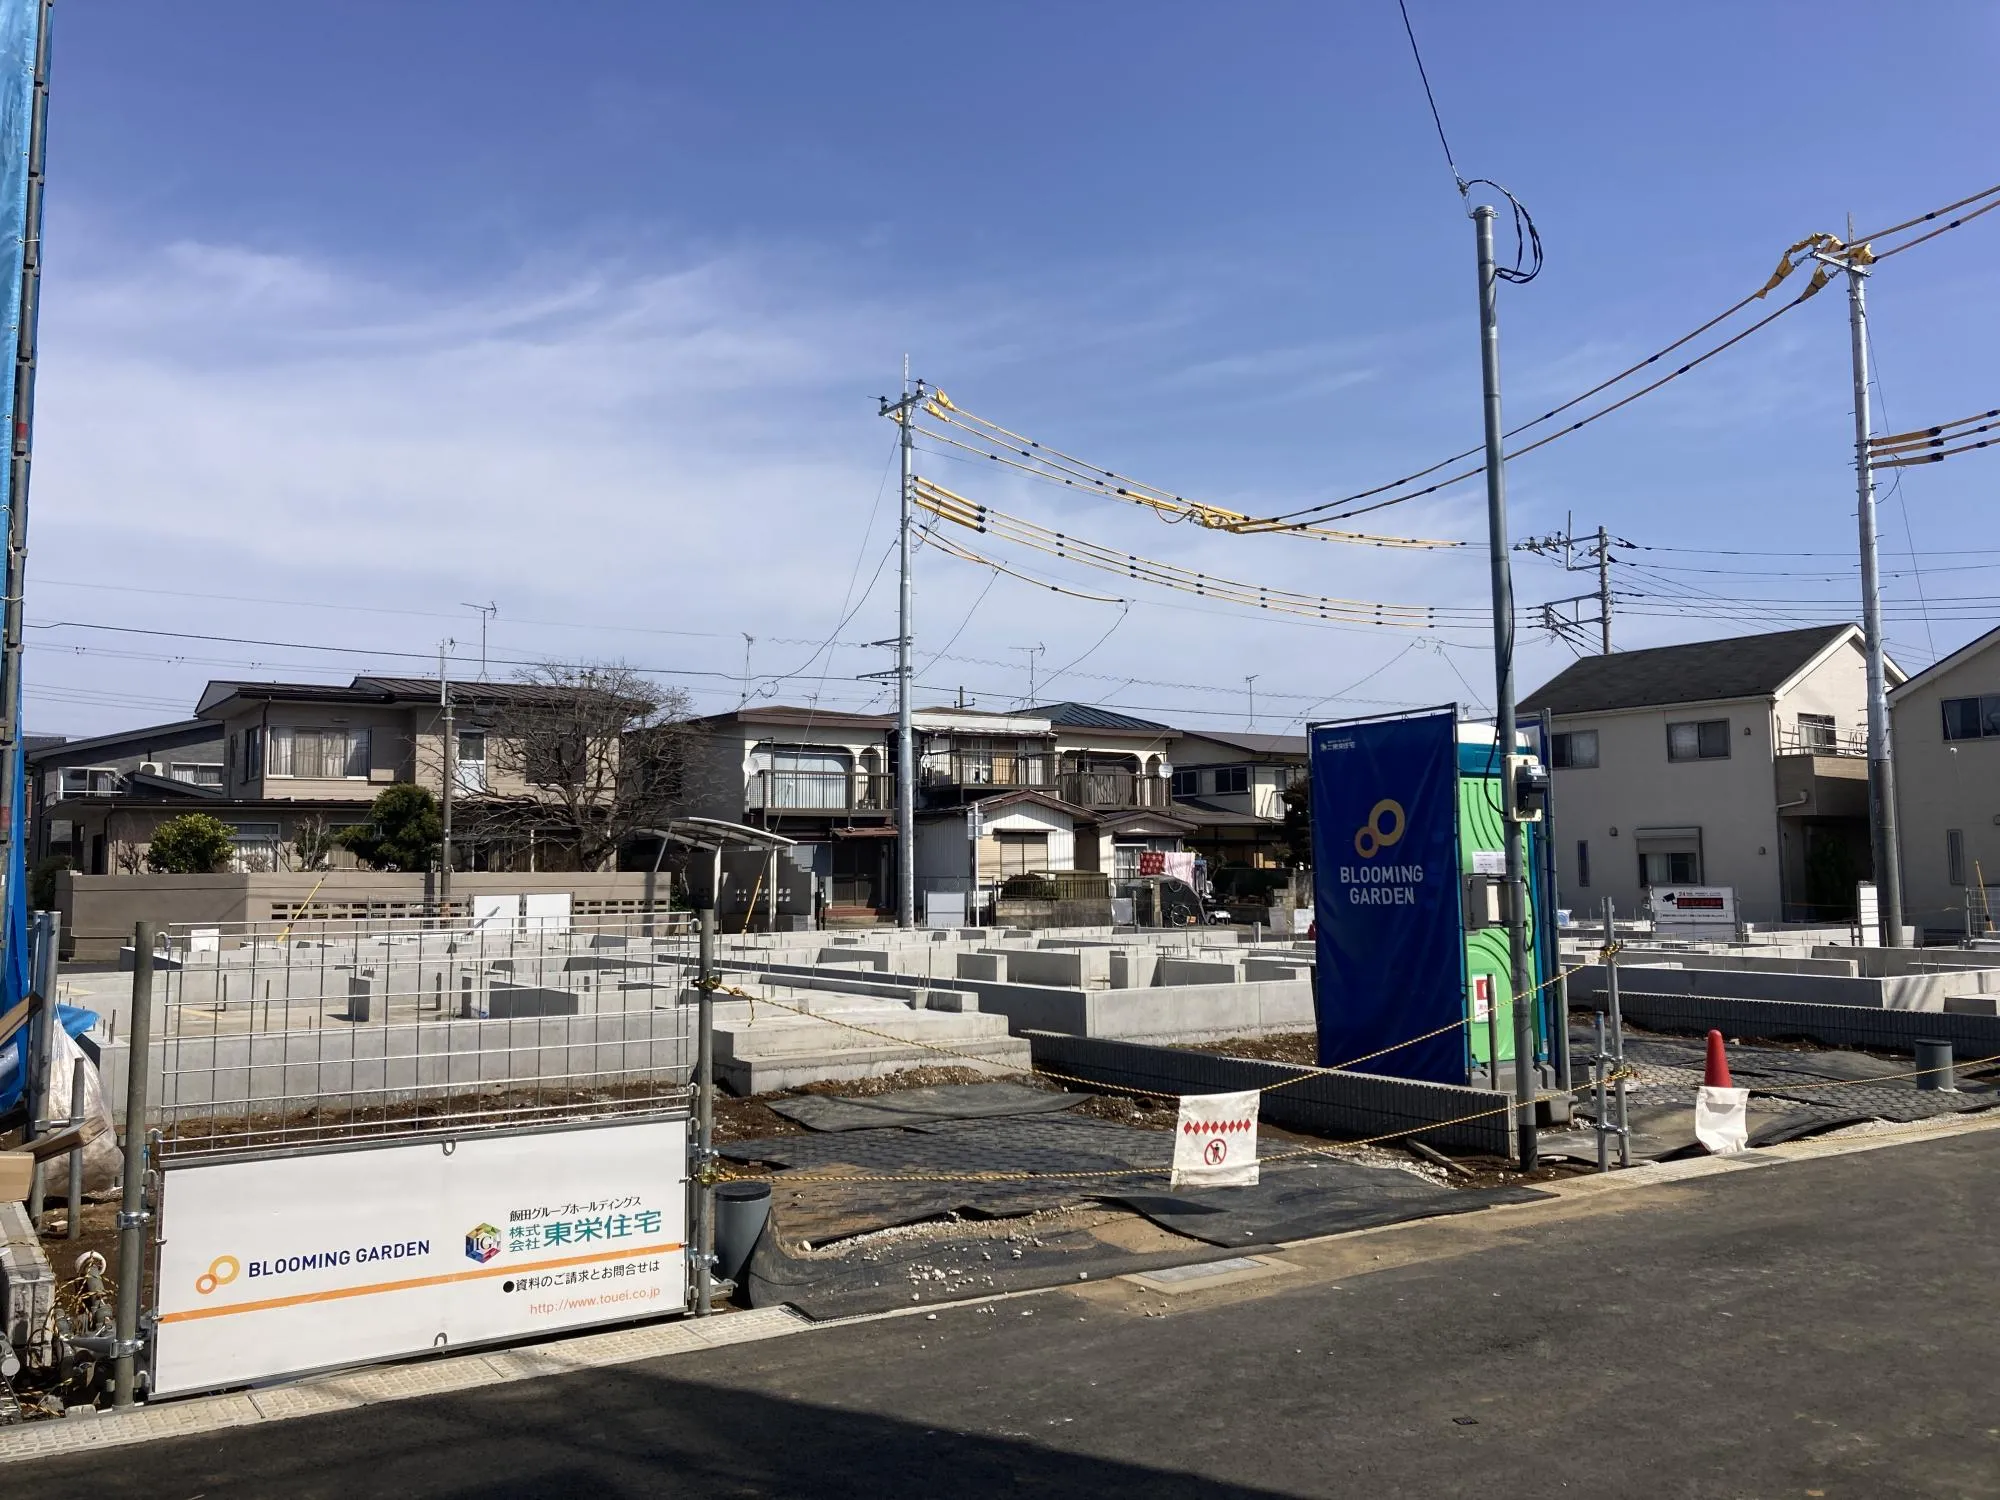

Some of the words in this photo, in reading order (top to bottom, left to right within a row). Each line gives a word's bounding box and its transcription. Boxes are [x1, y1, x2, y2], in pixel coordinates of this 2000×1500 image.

[1340, 865, 1424, 883] BLOOMING
[1349, 887, 1415, 905] GARDEN
[509, 1196, 641, 1222] 飯田グループホールディングス
[543, 1210, 662, 1247] 東栄住宅
[248, 1250, 351, 1278] BLOOMING
[355, 1239, 430, 1263] GARDEN
[529, 1287, 661, 1315] http://www.touei.co.jp
